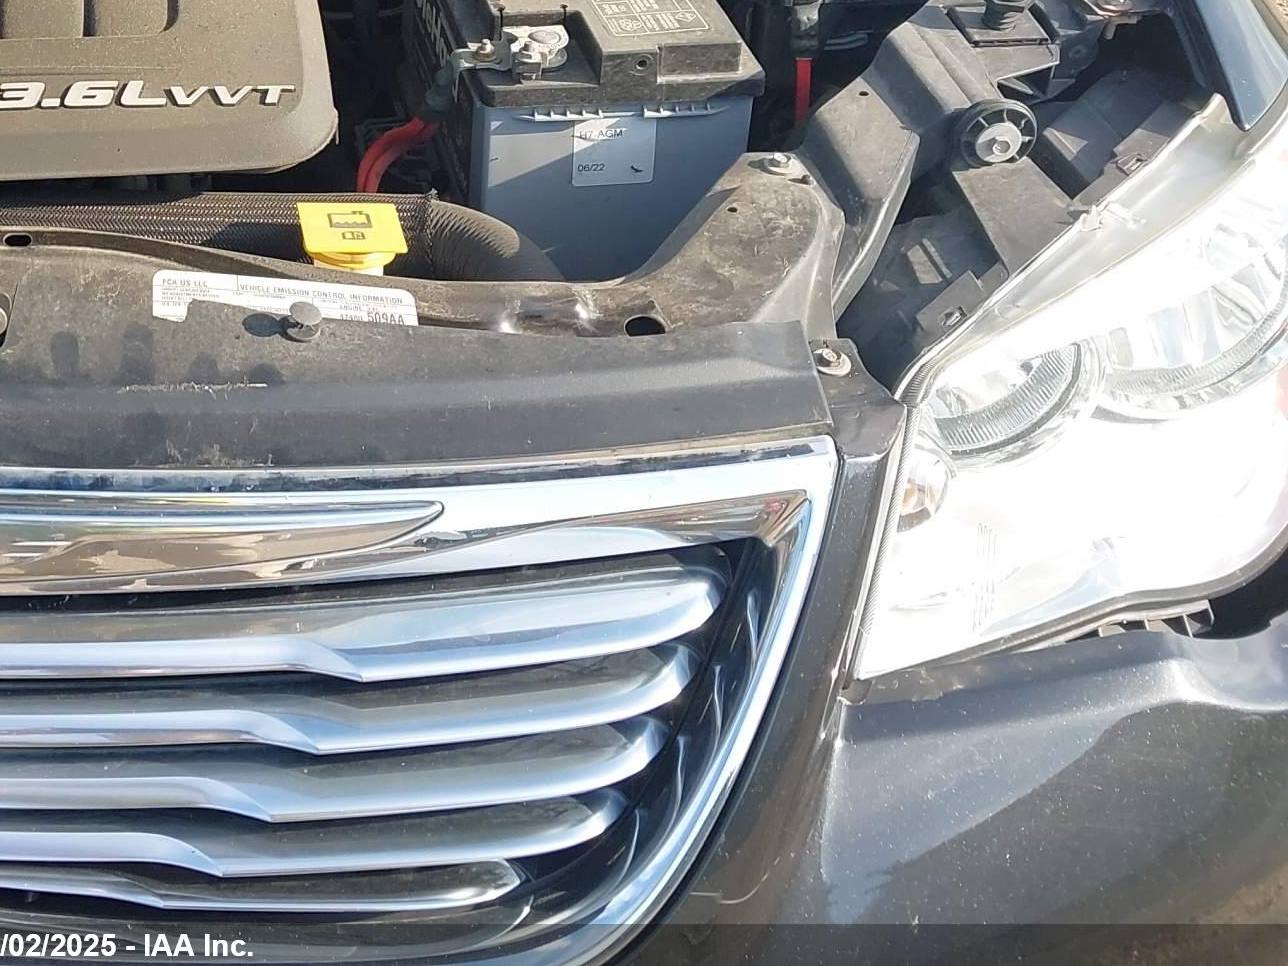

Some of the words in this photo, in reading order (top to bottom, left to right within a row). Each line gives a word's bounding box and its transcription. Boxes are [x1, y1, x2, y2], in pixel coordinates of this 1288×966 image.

[598, 129, 623, 139] AGM
[577, 163, 606, 172] 06/22
[240, 283, 270, 293] VEHICLE
[273, 287, 310, 297] EMISSION
[313, 290, 346, 301] CONTROL
[350, 294, 403, 305] INFORMATION
